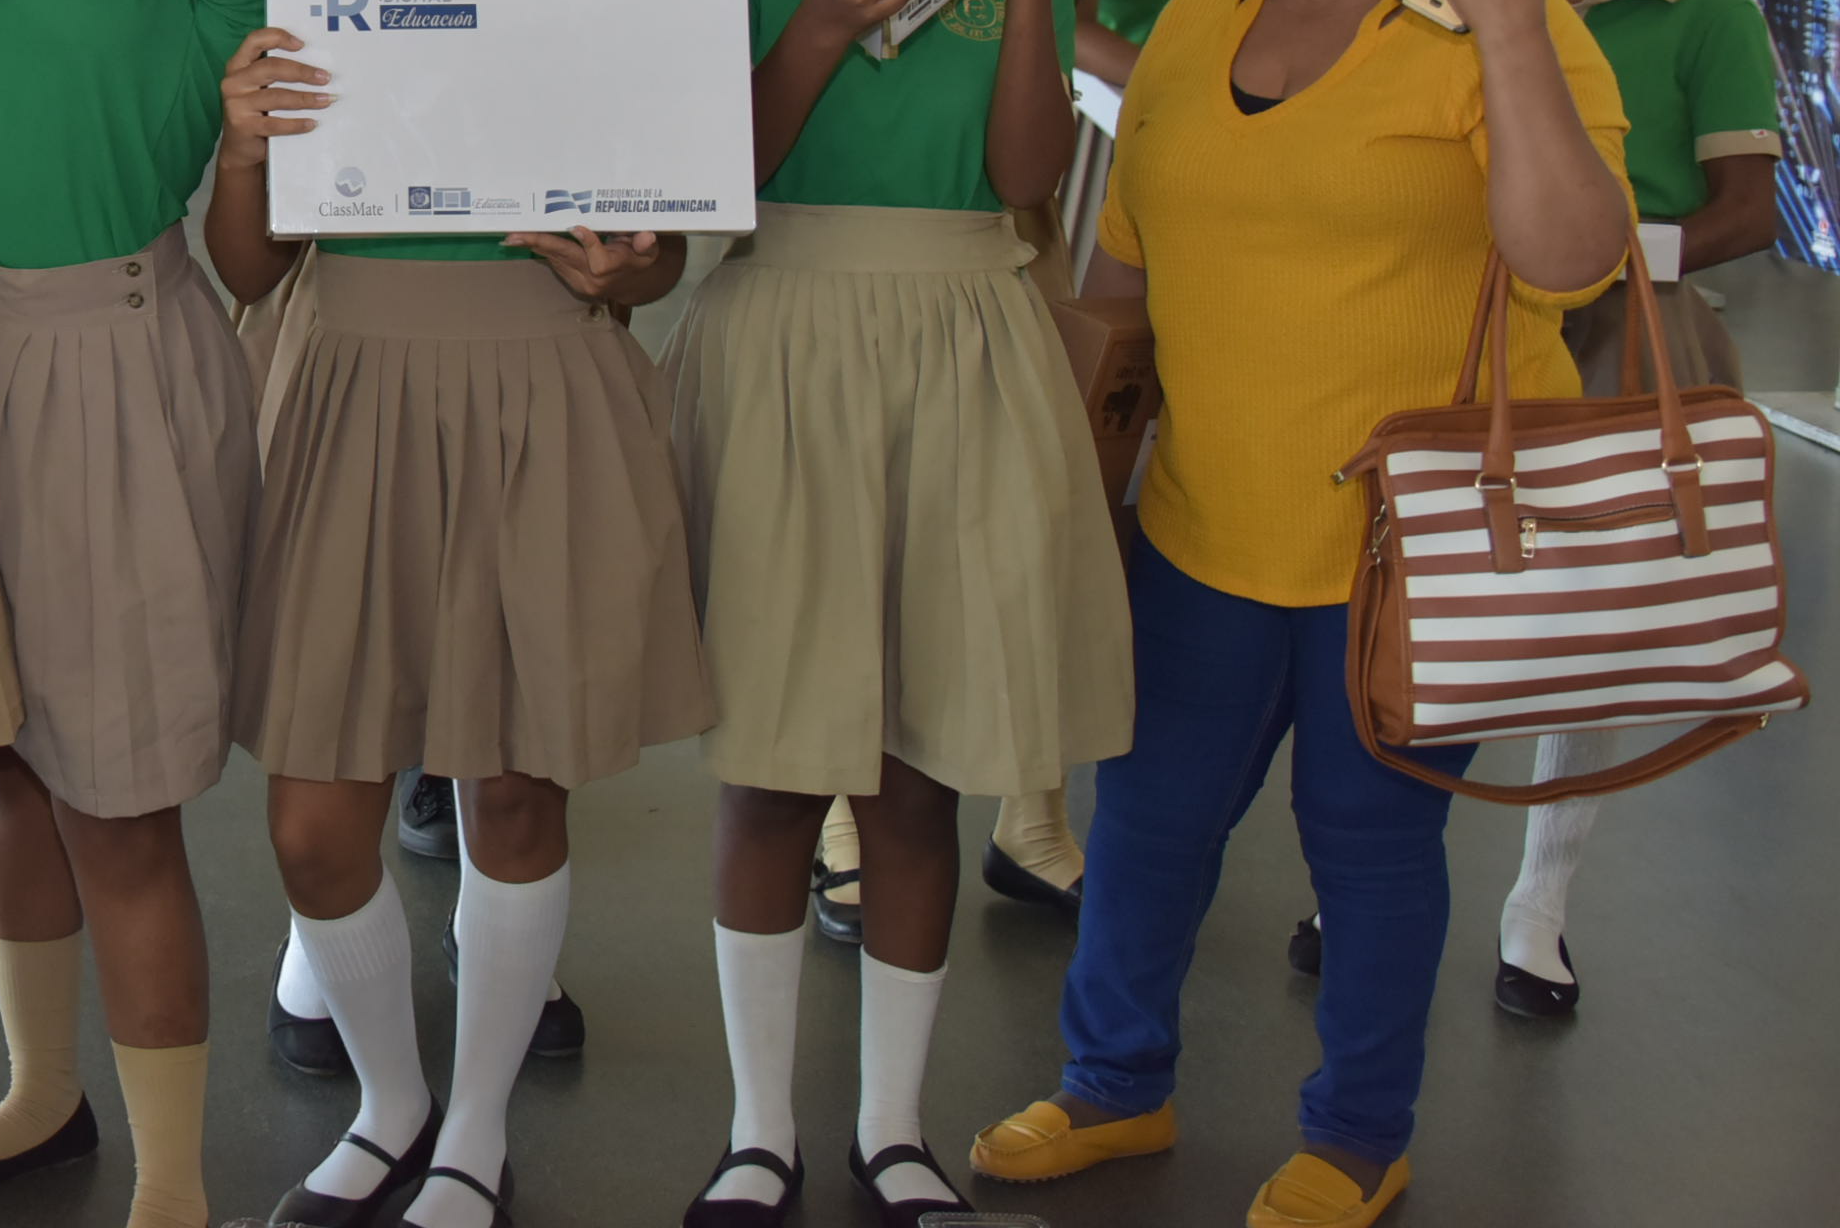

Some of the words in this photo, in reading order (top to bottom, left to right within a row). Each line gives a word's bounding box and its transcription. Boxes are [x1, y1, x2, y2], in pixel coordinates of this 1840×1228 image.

[382, 7, 475, 28] Educación
[597, 188, 642, 198] PRESIDENCIA
[643, 188, 653, 198] DE
[654, 188, 663, 198] LA
[318, 201, 384, 217] ClassMate
[595, 198, 650, 213] REPÚBLICA
[652, 199, 717, 213] DOMINICANA
